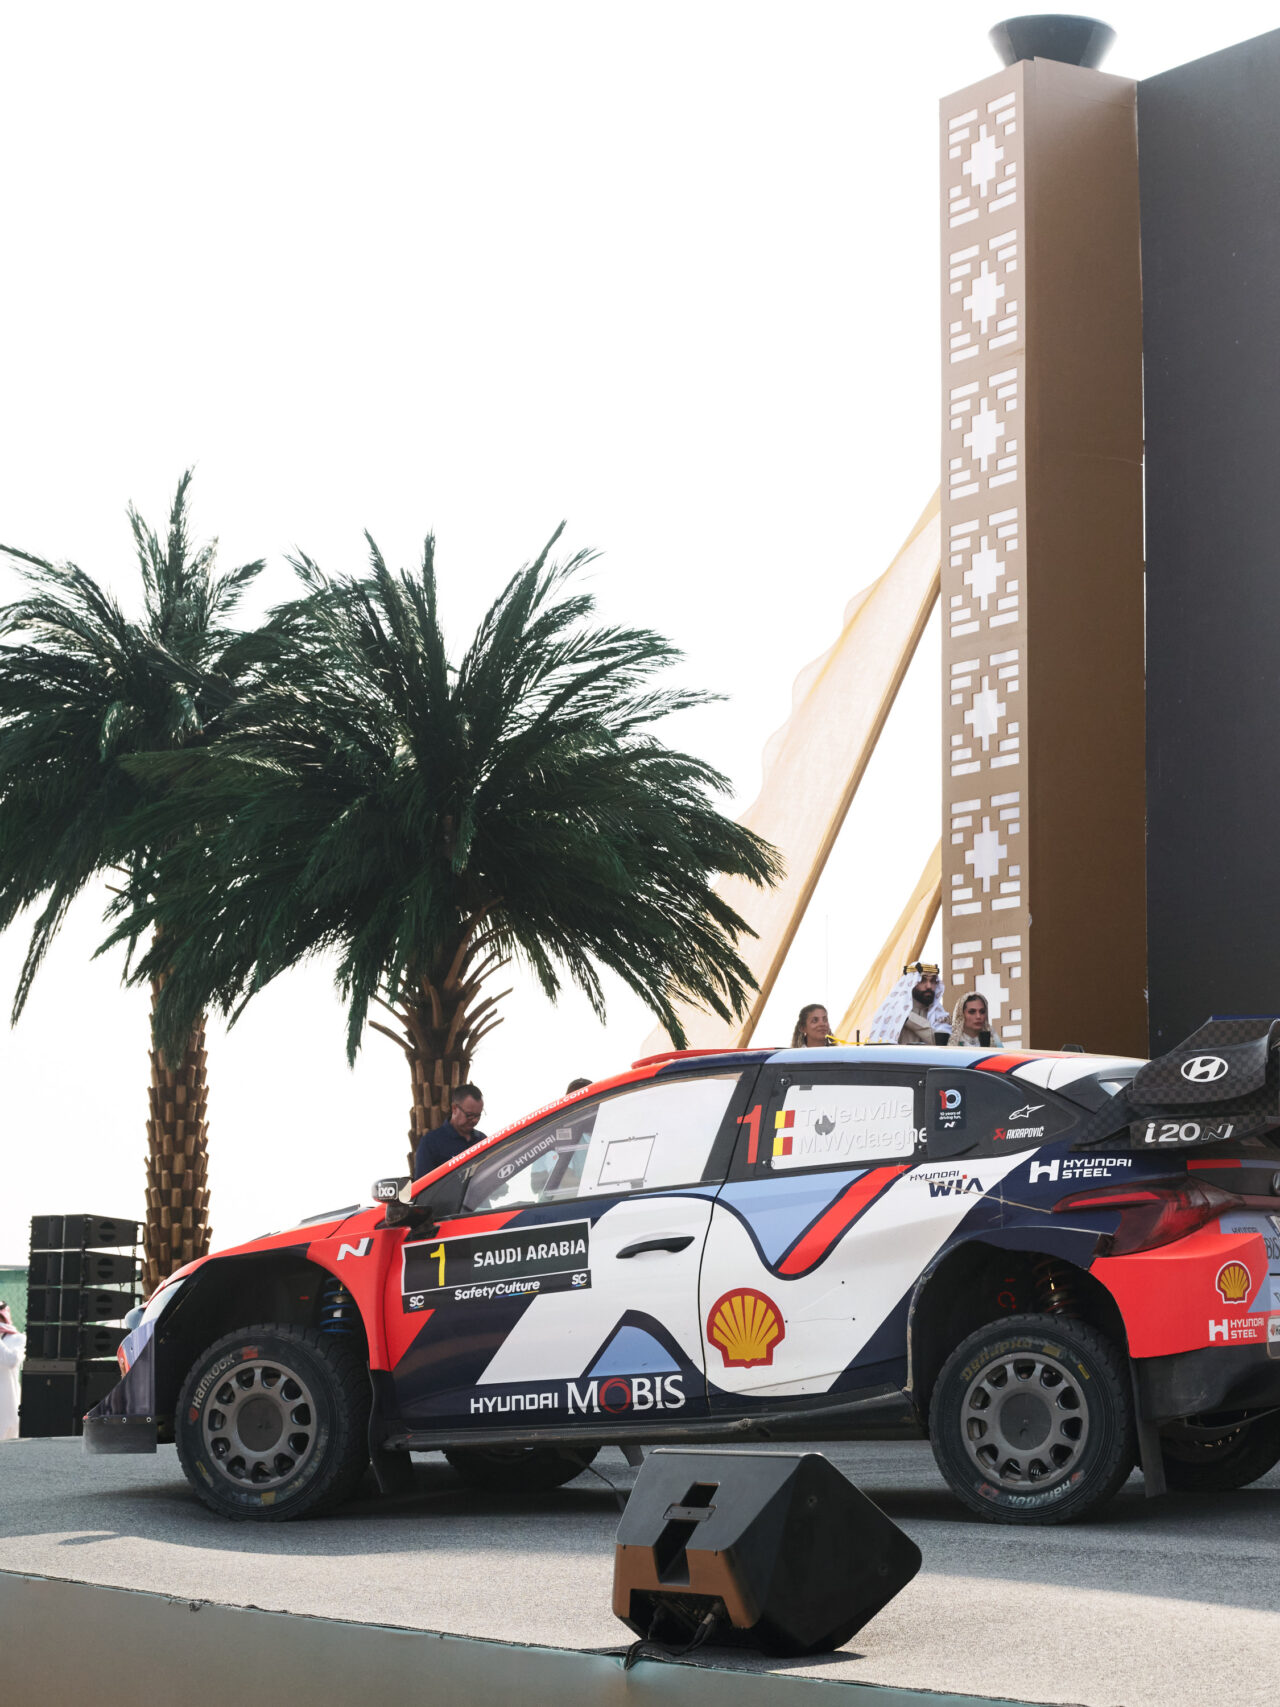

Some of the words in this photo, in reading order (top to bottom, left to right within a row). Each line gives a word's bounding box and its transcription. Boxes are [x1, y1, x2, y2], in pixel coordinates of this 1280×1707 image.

[448, 1087, 589, 1167] motorsport.hyundai.com
[736, 1104, 762, 1164] 1
[515, 1134, 556, 1167] HYUNDAI
[798, 1125, 927, 1155] M.Wydaeghe
[1062, 1168, 1112, 1179] STEEL
[1063, 1158, 1132, 1168] HYUNDAI
[910, 1170, 959, 1181] HYUNDAI
[928, 1174, 984, 1198] WIA
[1266, 1236, 1280, 1260] BIS
[430, 1243, 446, 1287] 1
[473, 1247, 521, 1268] SAUDI
[526, 1239, 586, 1261] ARABIA
[454, 1279, 540, 1301] SafetyCulture
[571, 1273, 588, 1286] SC
[409, 1295, 424, 1308] SC
[1230, 1317, 1264, 1327] HYUNDAI
[1231, 1329, 1257, 1339] STEEL
[470, 1392, 559, 1414] HYUNDAI
[566, 1375, 686, 1415] MOBIS
